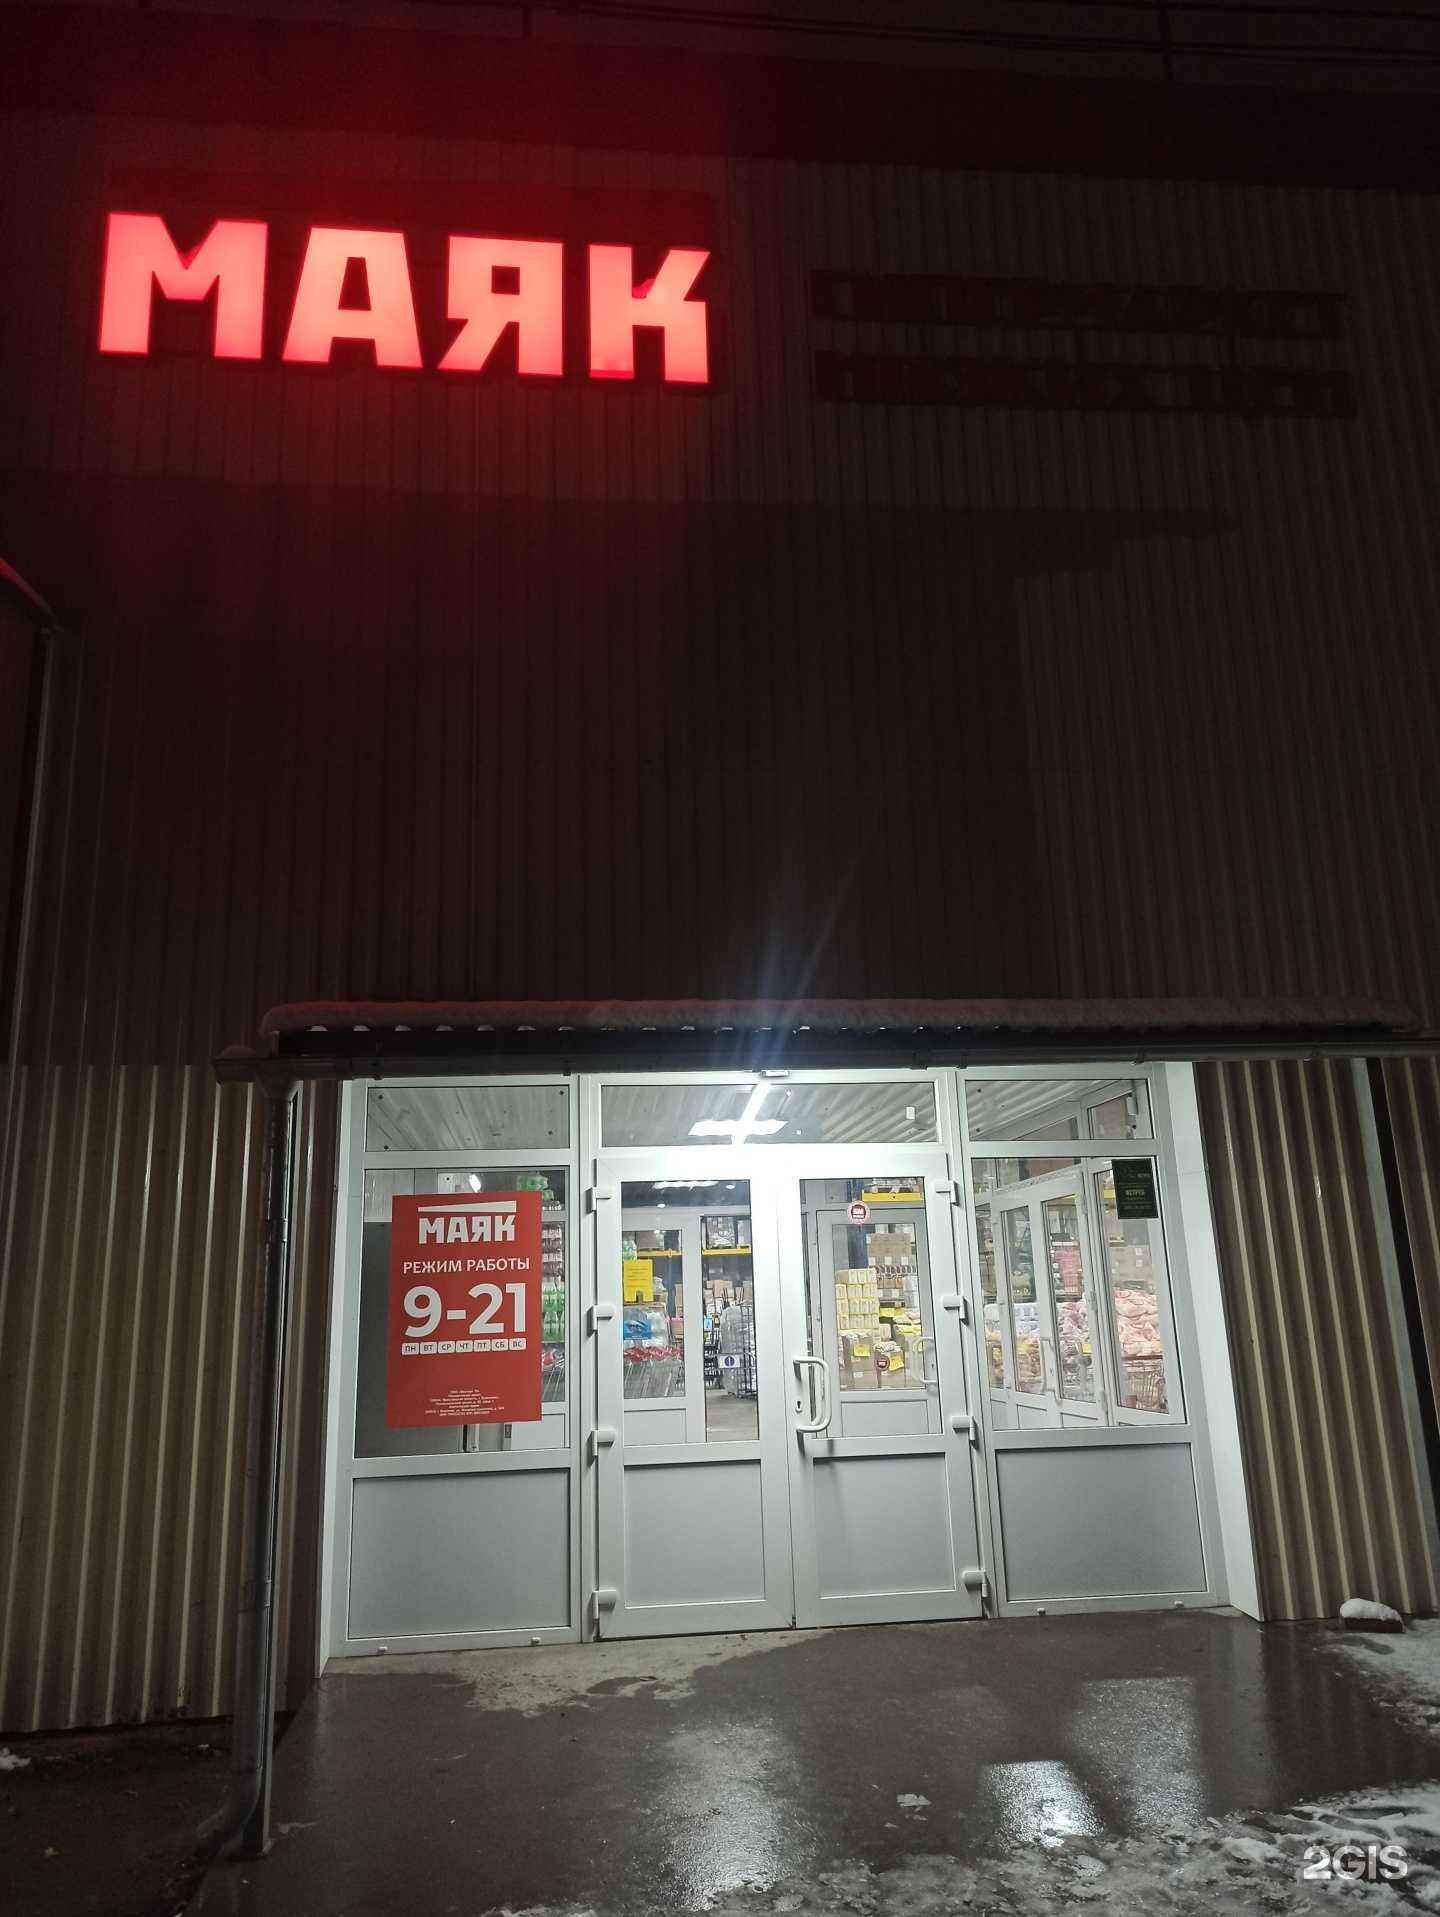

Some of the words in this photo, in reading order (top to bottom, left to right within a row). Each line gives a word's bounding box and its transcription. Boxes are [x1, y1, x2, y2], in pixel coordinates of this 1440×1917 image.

[98, 211, 711, 384] МАЯК
[417, 1214, 516, 1244] МАЯК
[402, 1259, 463, 1275] РЕЖИМ
[466, 1257, 531, 1272] РАБОТЫ
[403, 1282, 527, 1338] 9-21
